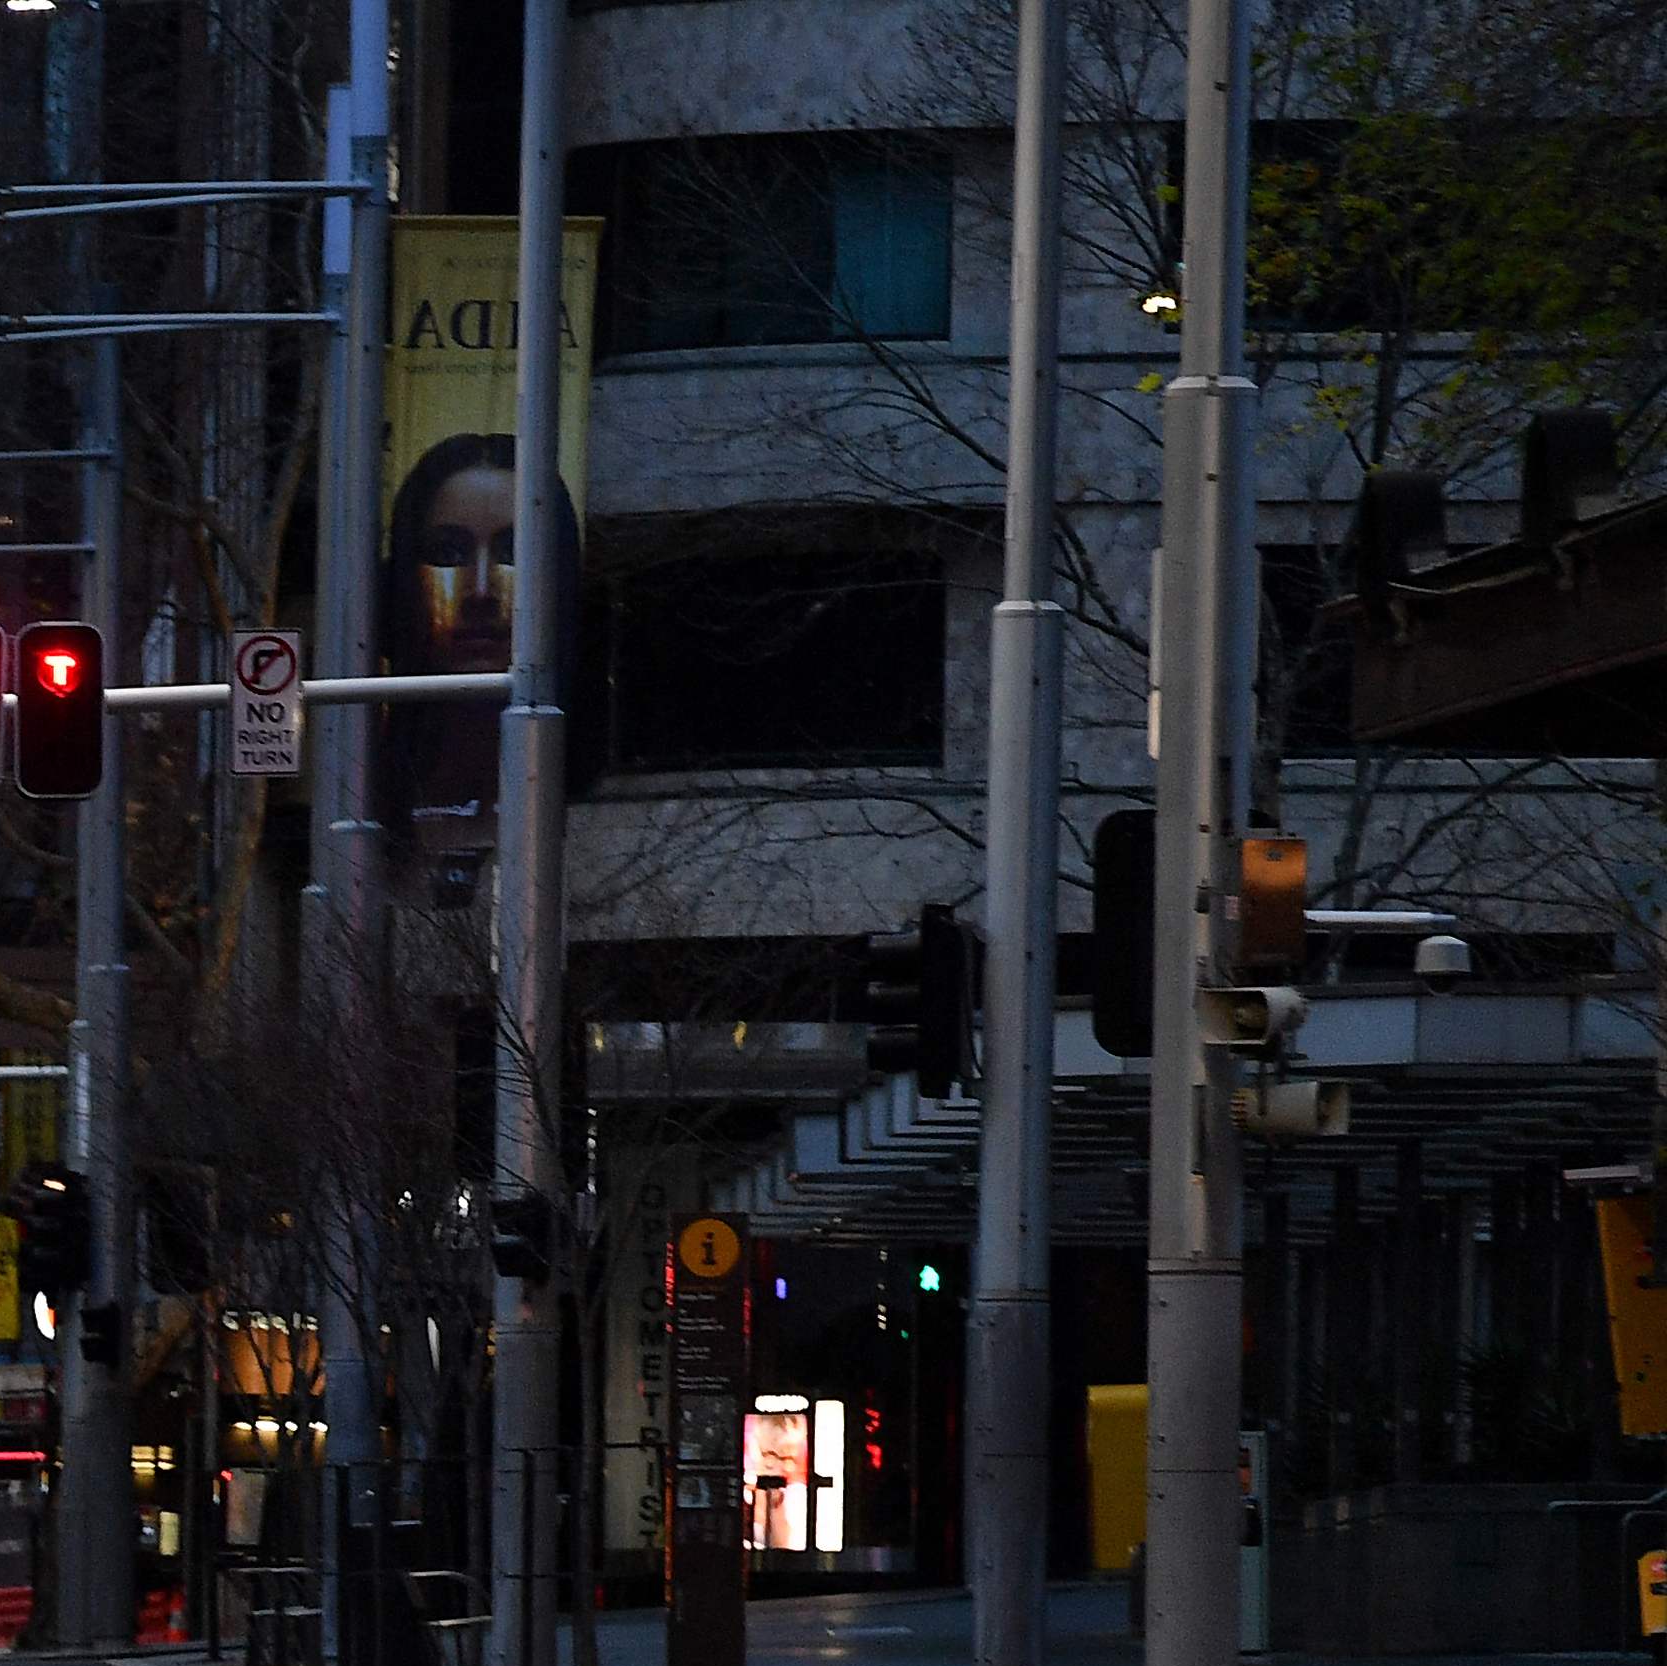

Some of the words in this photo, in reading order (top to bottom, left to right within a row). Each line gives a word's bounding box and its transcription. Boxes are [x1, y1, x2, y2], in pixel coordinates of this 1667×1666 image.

[246, 702, 285, 723] NO
[238, 729, 294, 745] RIGHT
[241, 751, 292, 765] TURN
